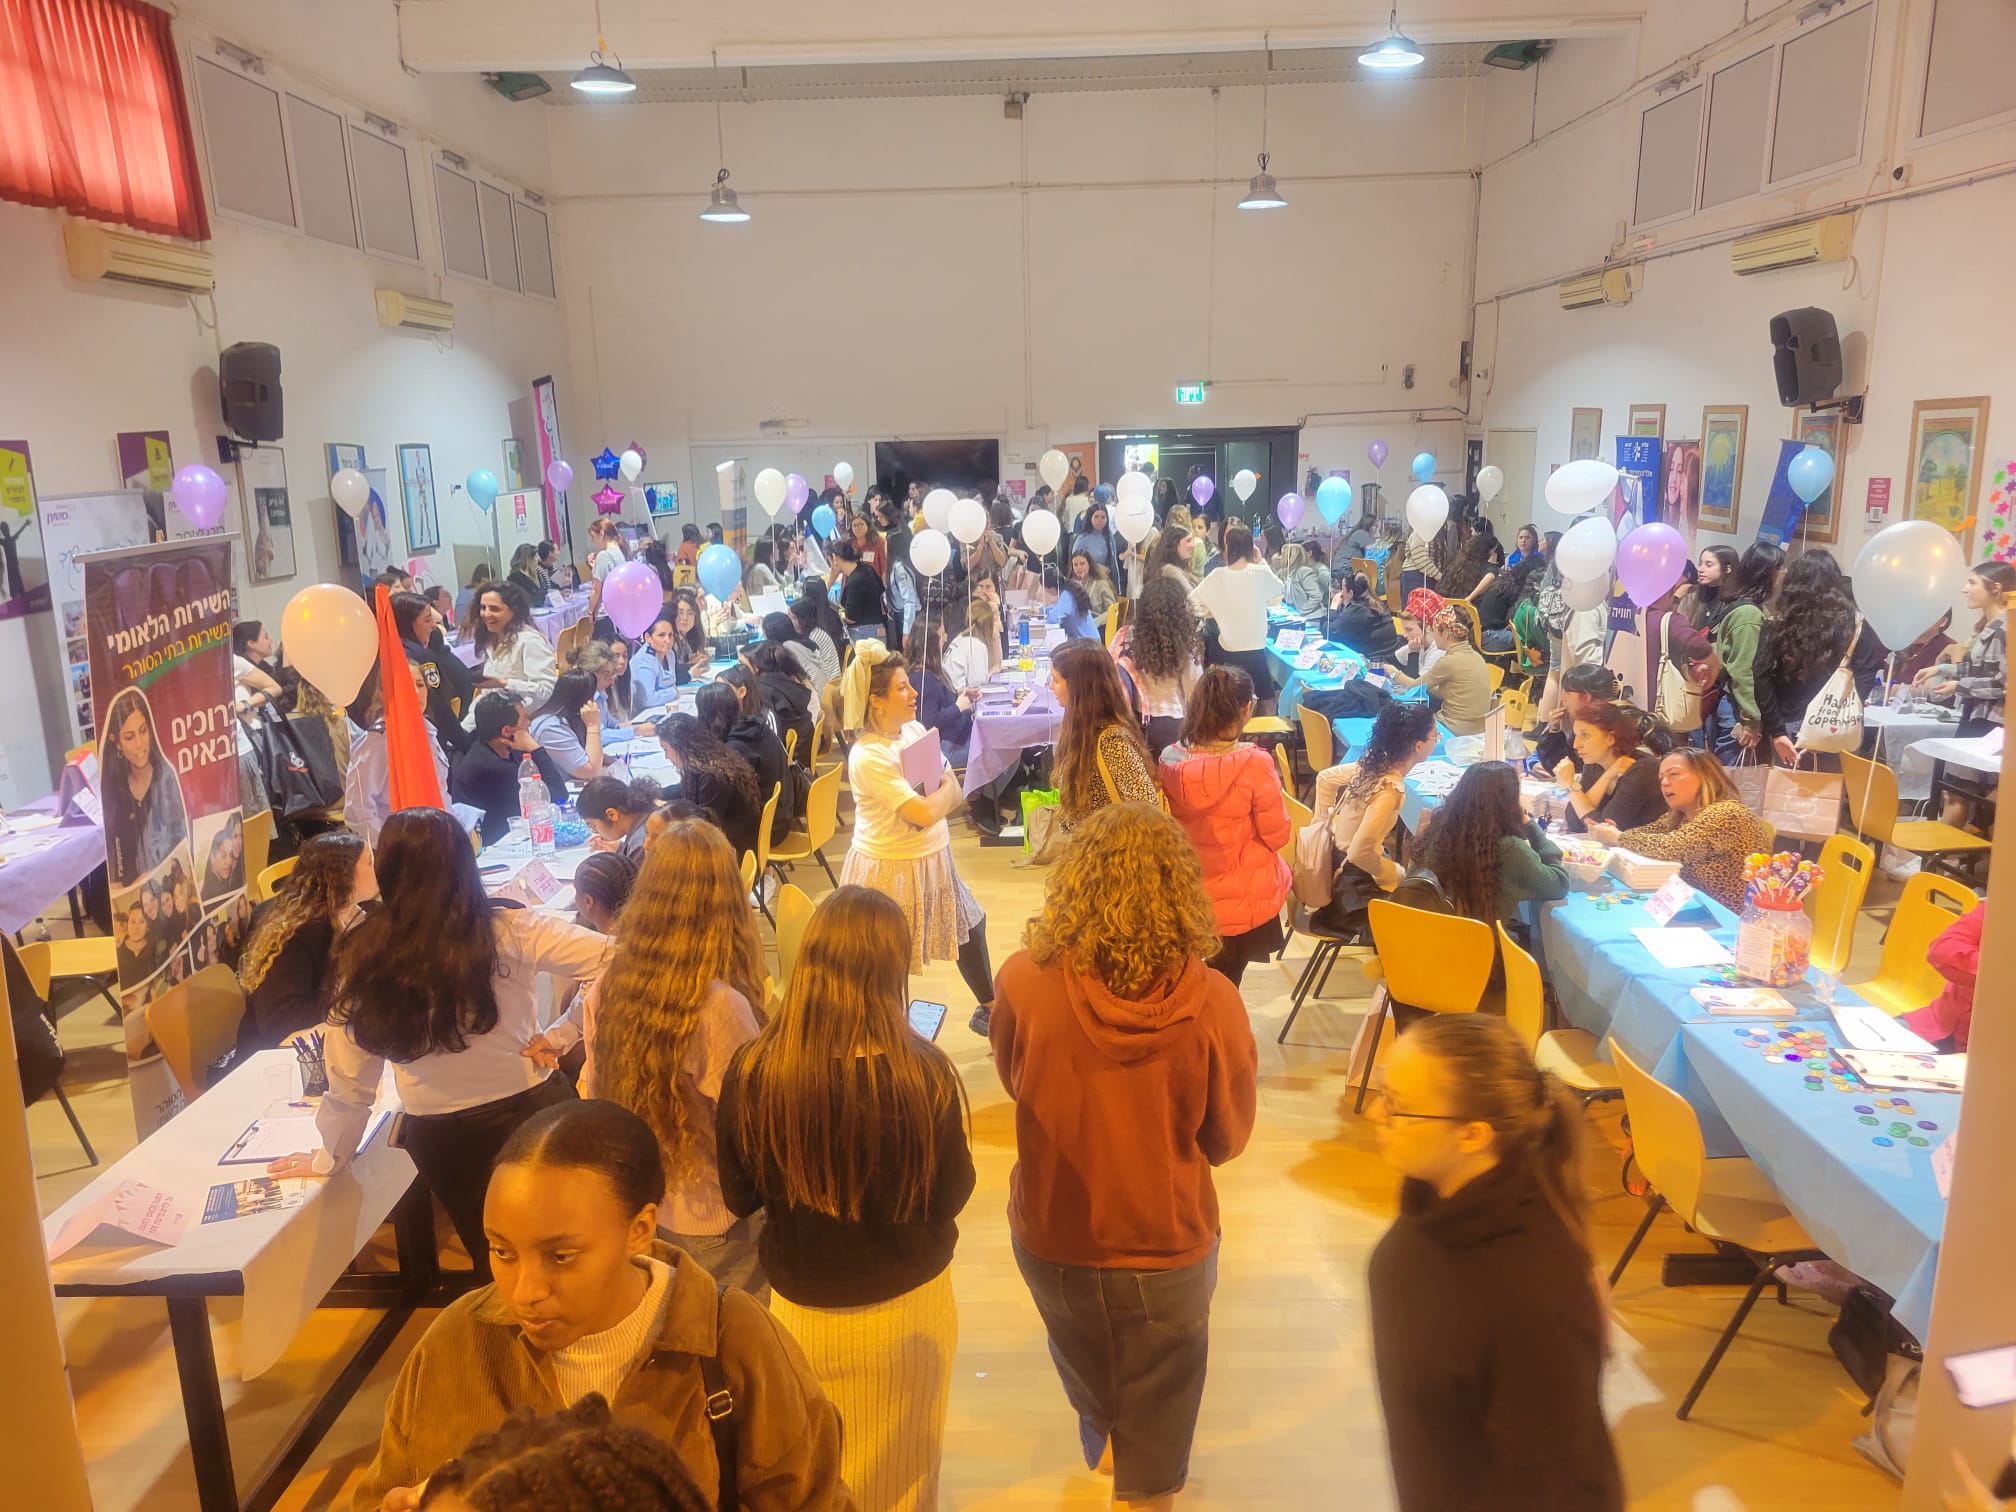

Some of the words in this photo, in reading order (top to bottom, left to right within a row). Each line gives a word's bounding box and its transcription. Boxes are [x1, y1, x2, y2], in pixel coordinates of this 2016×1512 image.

[174, 588, 230, 629] השירות
[107, 613, 170, 655] הלאומי
[188, 621, 230, 651] בשירות
[122, 650, 163, 679] הסוהר
[163, 640, 186, 662] בתי
